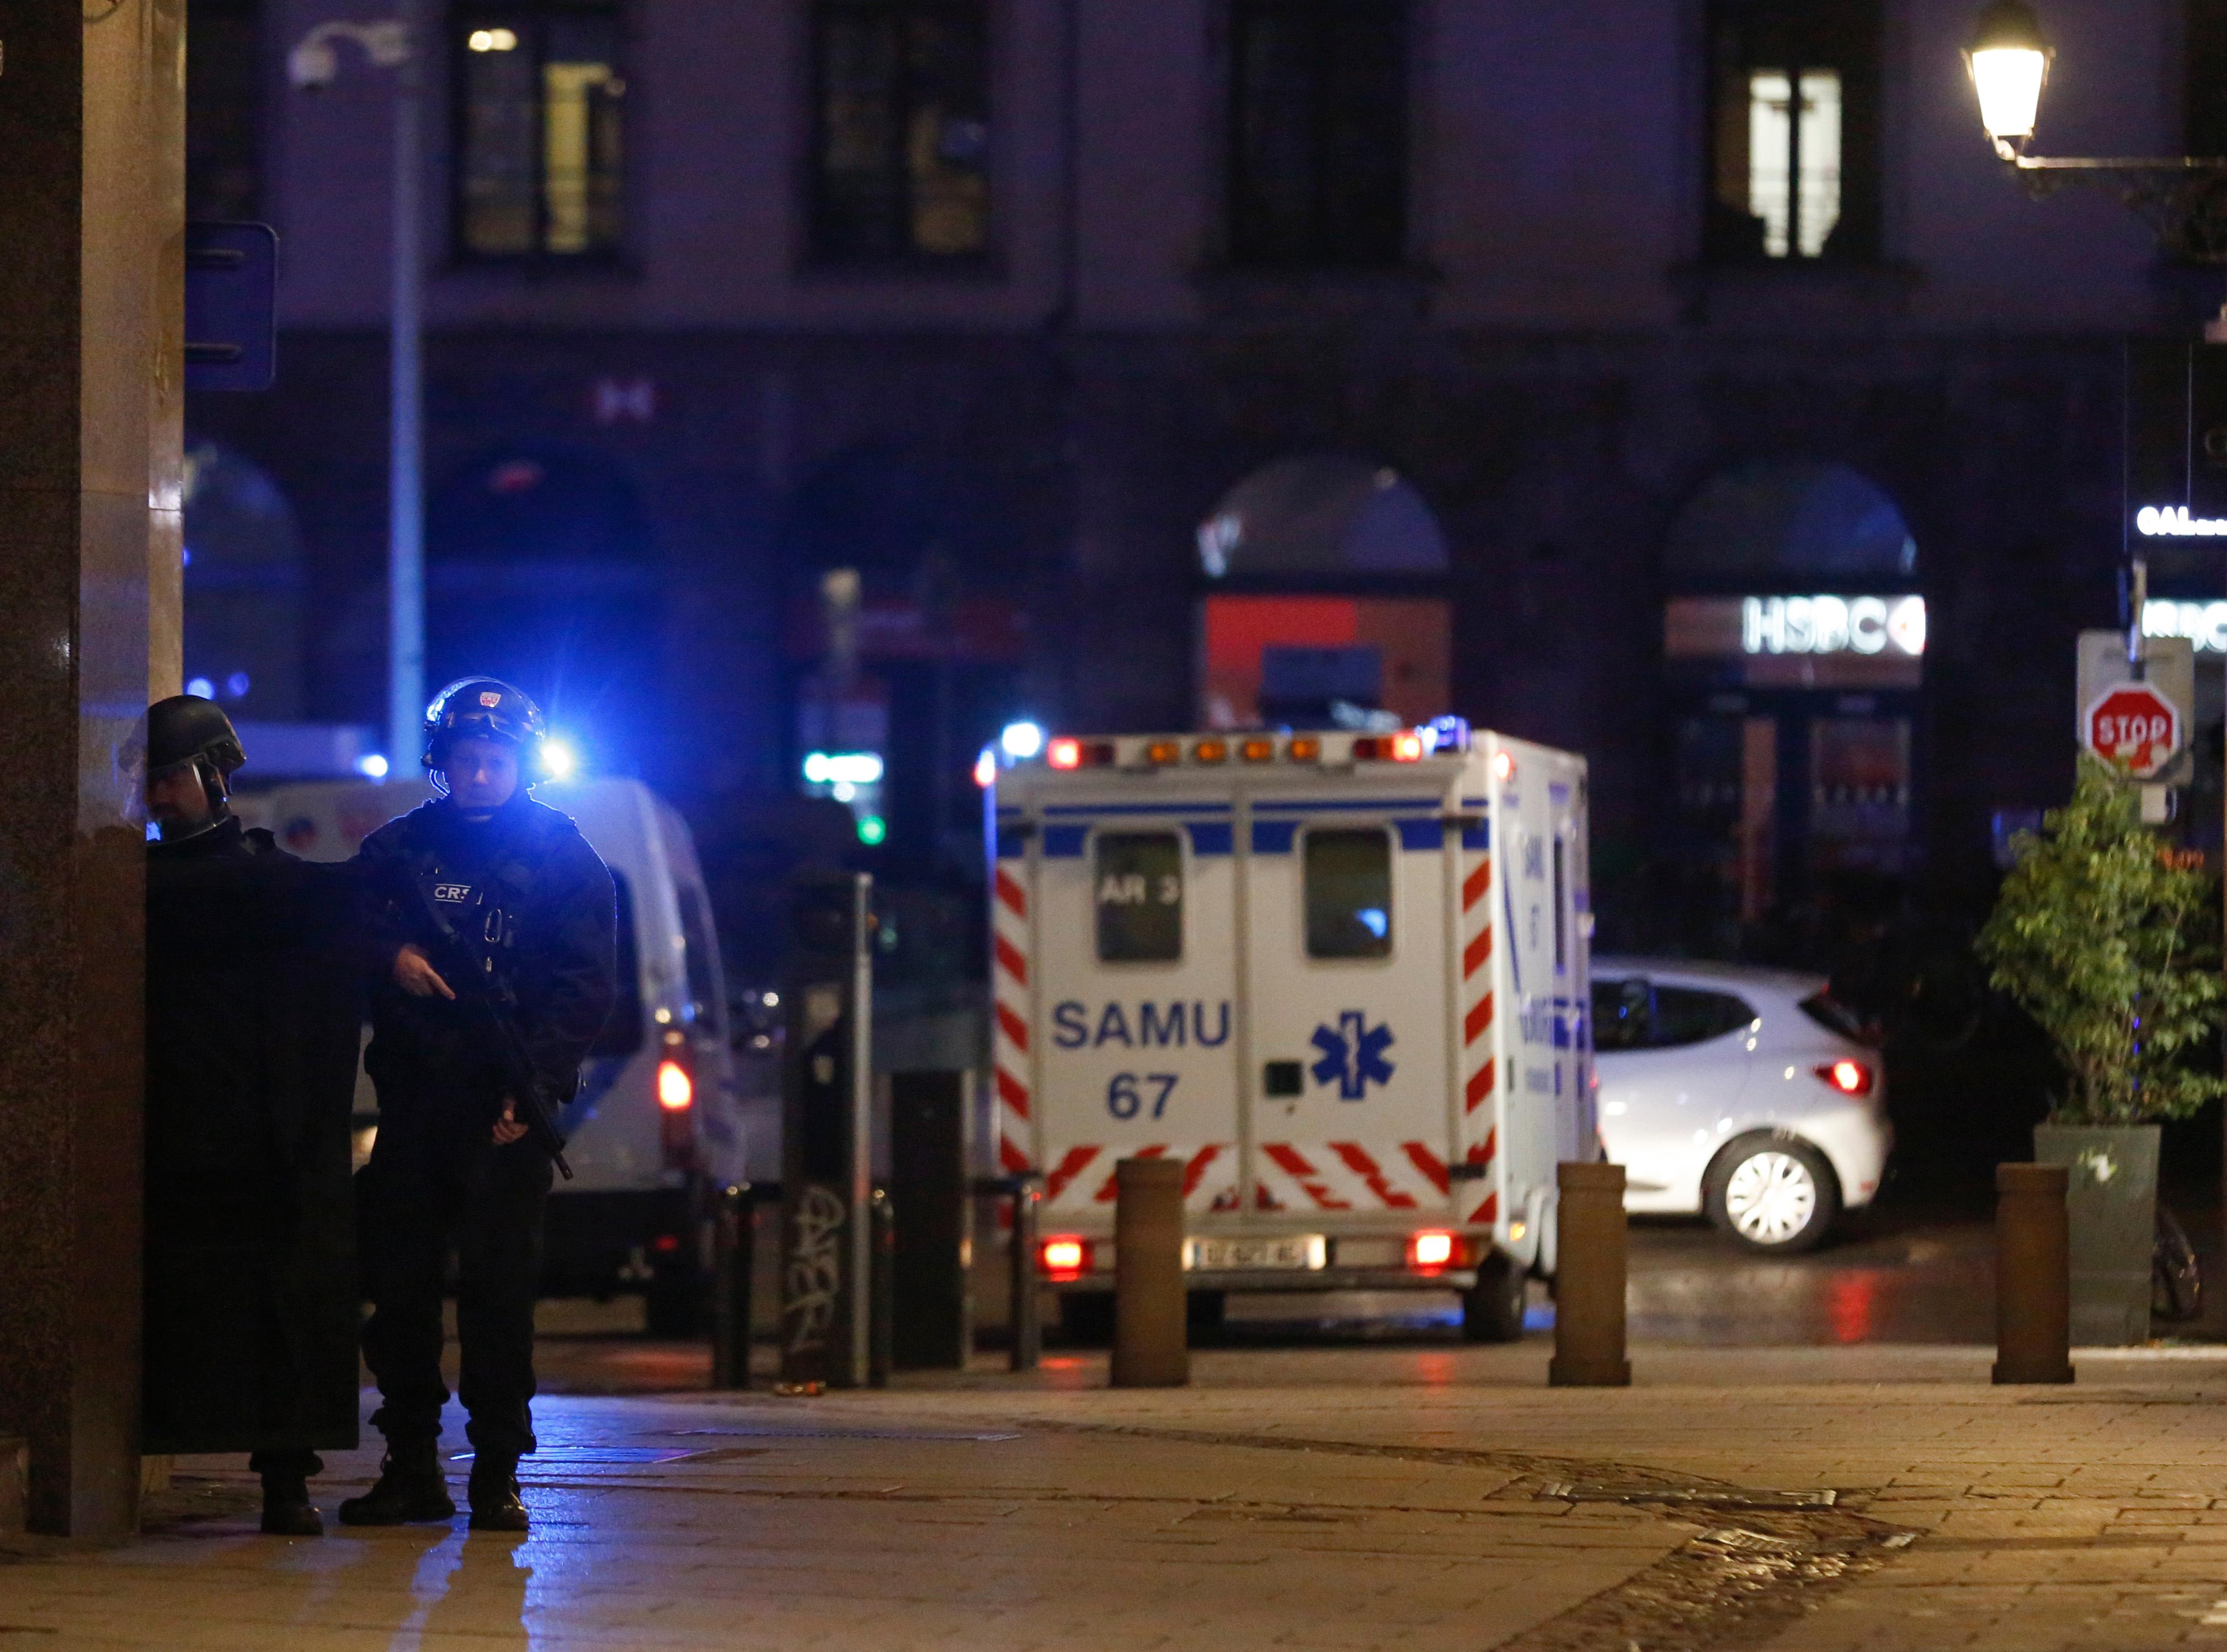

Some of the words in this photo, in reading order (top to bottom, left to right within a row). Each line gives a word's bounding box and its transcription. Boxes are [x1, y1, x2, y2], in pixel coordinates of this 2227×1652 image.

[2098, 715, 2167, 745] STOP
[1101, 875, 1146, 905] AR
[1053, 1000, 1230, 1048] SAMU
[1107, 1072, 1179, 1121] 67
